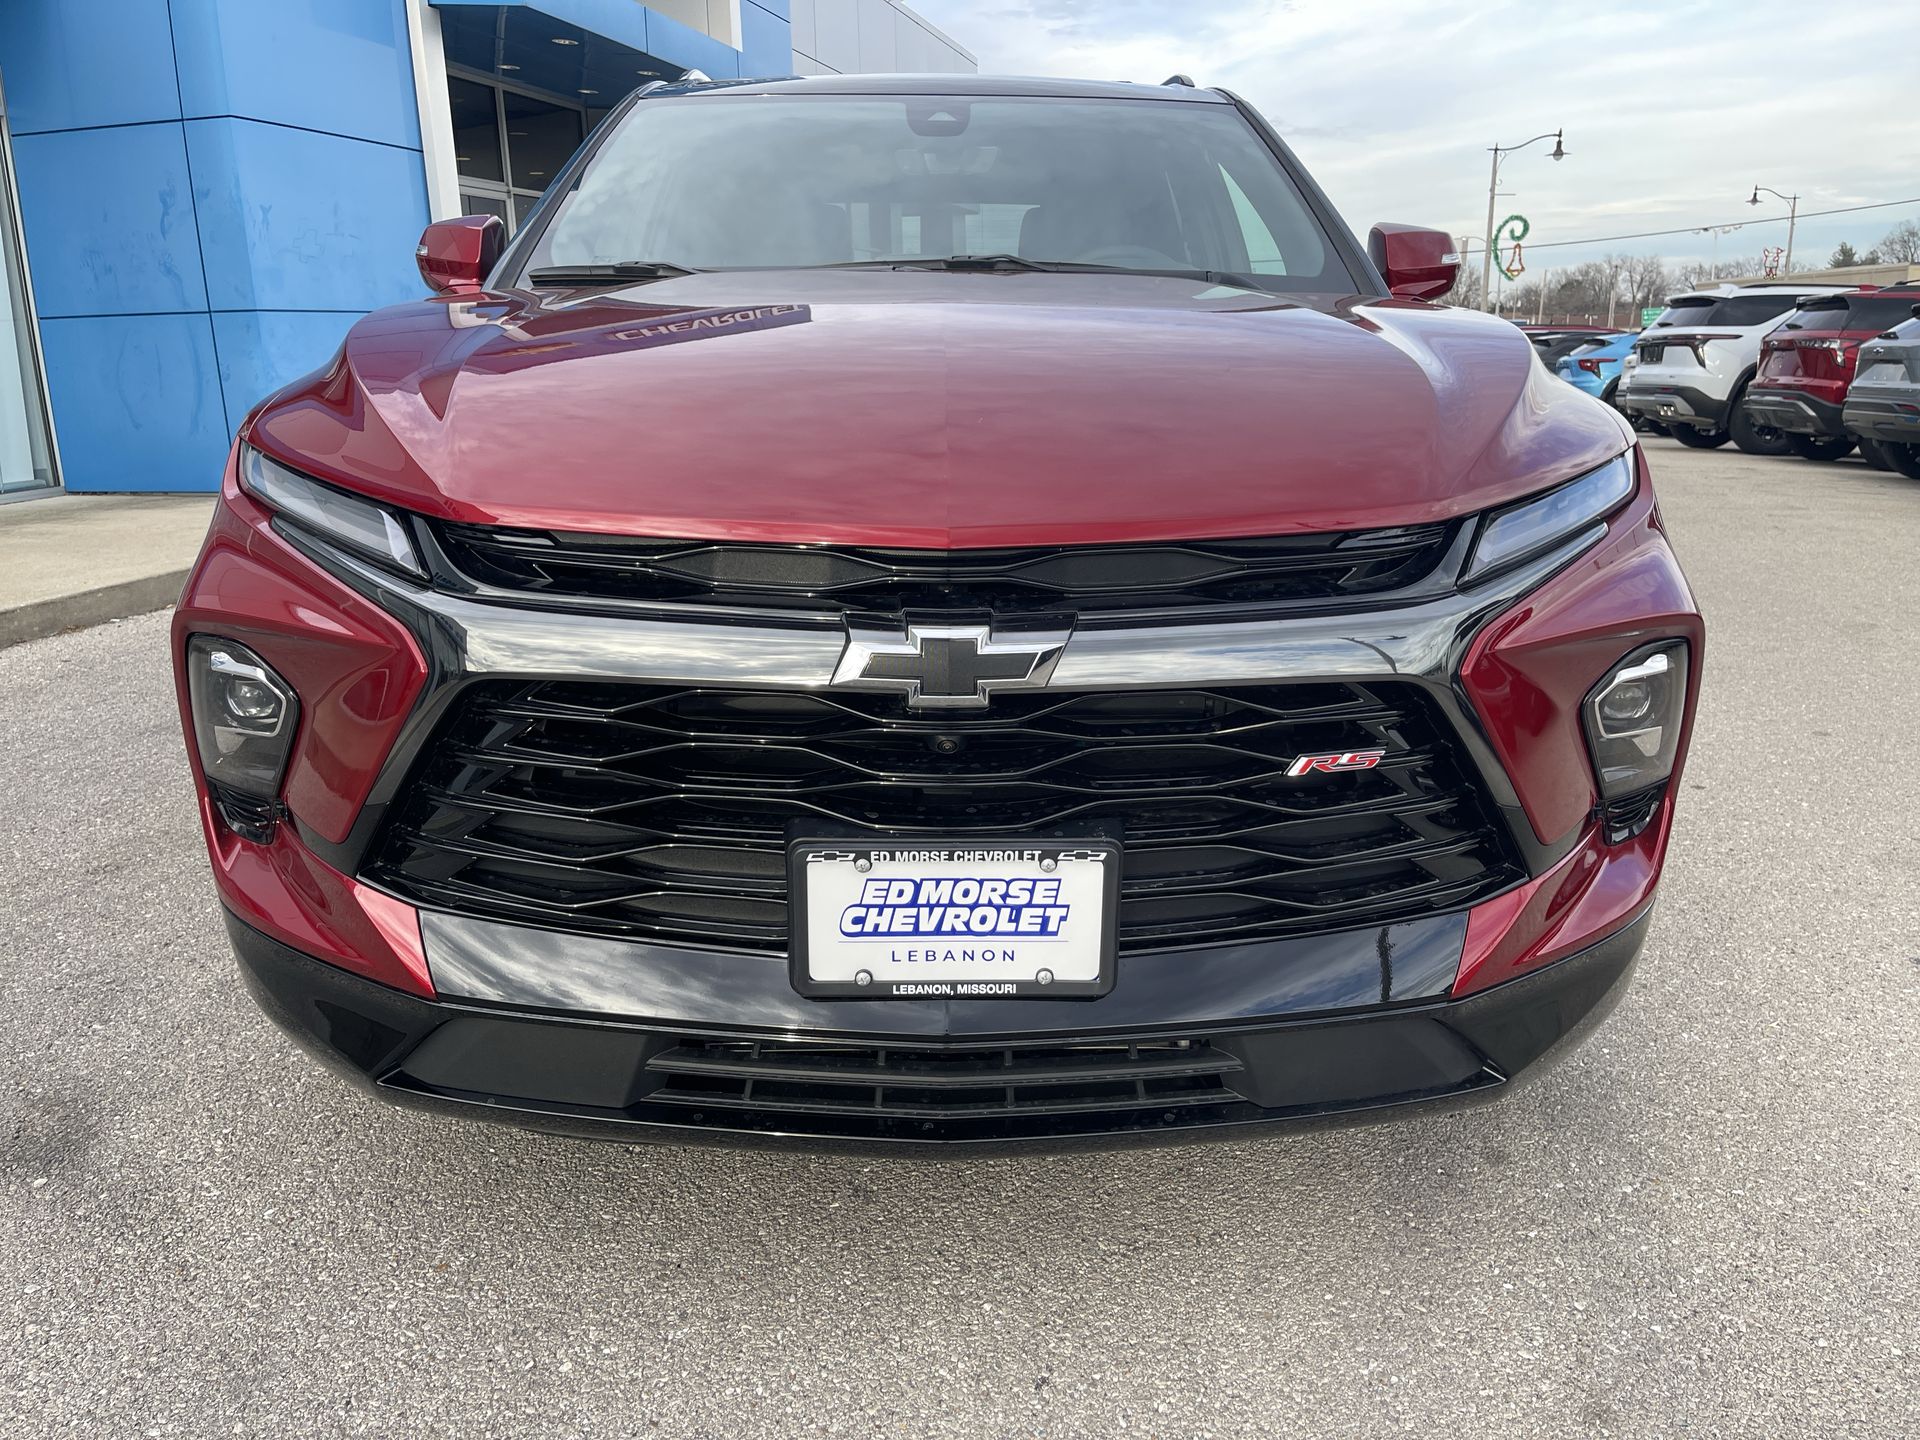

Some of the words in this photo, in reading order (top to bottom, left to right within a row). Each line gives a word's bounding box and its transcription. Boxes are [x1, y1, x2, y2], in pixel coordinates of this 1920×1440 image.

[1286, 750, 1386, 777] RS
[870, 850, 891, 863] ED
[894, 850, 950, 863] MORSE
[953, 850, 1042, 863] CHEVROLET
[860, 878, 916, 905] ED
[917, 878, 1062, 905] MORSE
[839, 904, 1071, 937] CHEVROLET
[891, 949, 1016, 962] LEBANON
[892, 983, 954, 996] LEBANON,
[956, 983, 1017, 995] MISSOURI
